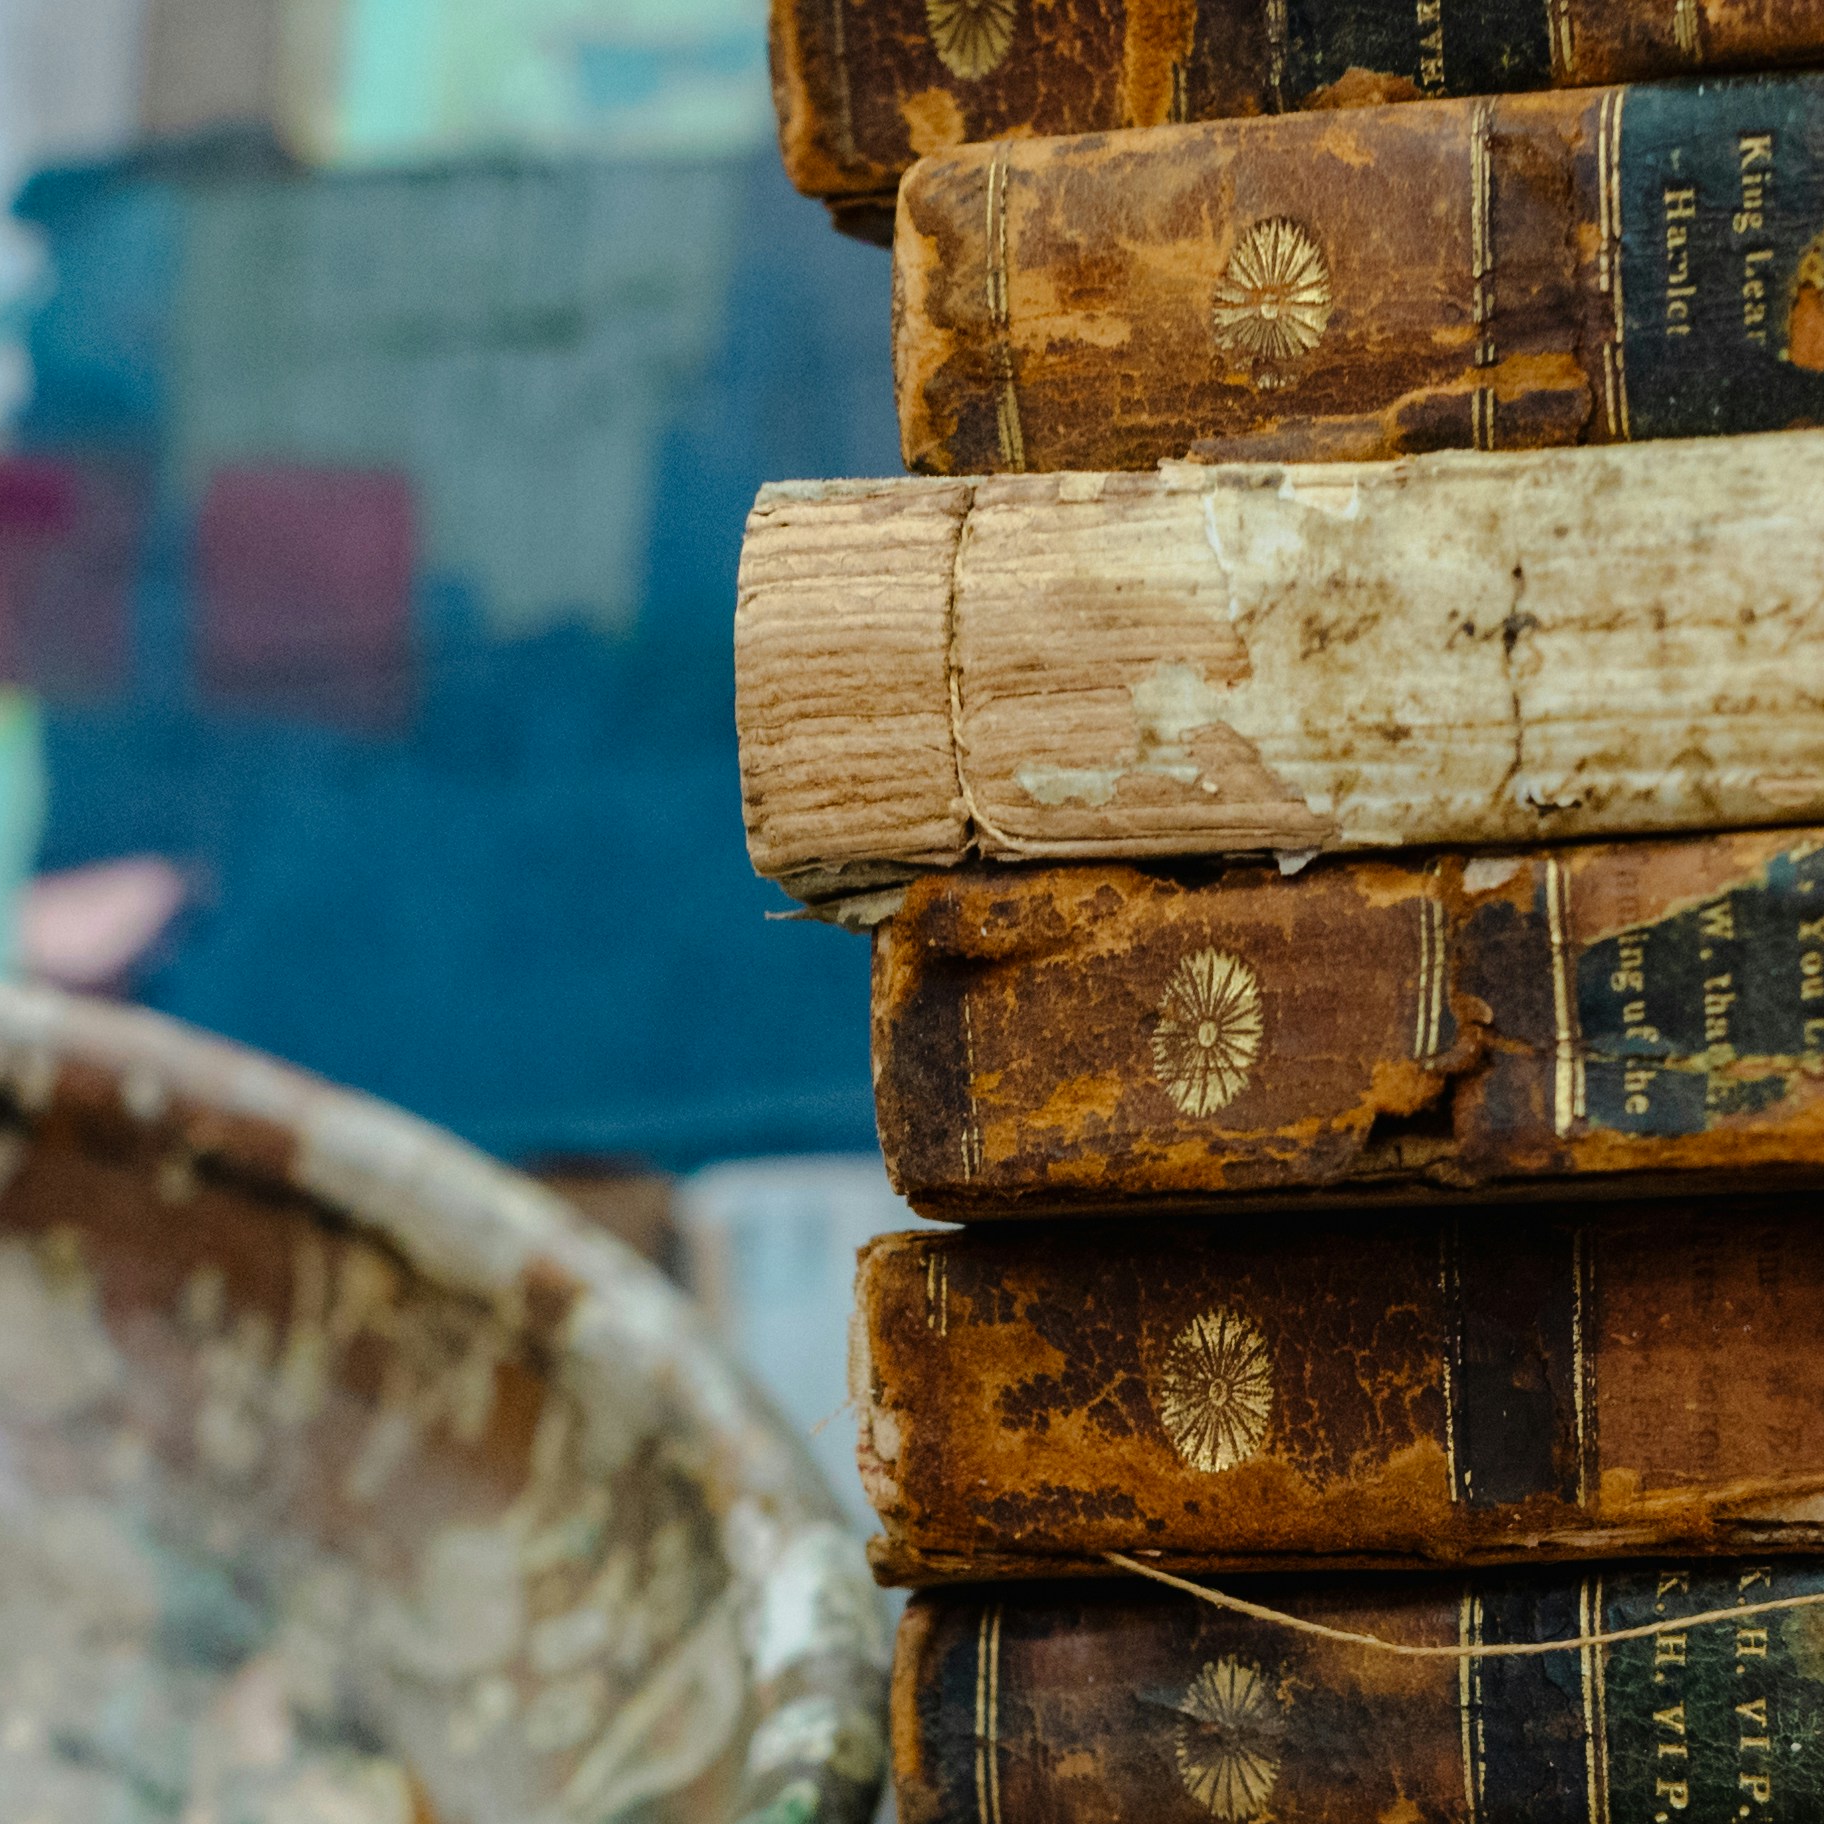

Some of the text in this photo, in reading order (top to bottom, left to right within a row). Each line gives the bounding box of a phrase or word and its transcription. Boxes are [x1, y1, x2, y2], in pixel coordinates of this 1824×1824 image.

[1663, 187, 1697, 338] Hamlet
[1732, 134, 1774, 346] King Lear
[1698, 900, 1735, 961] W.
[1623, 1058, 1658, 1114] he
